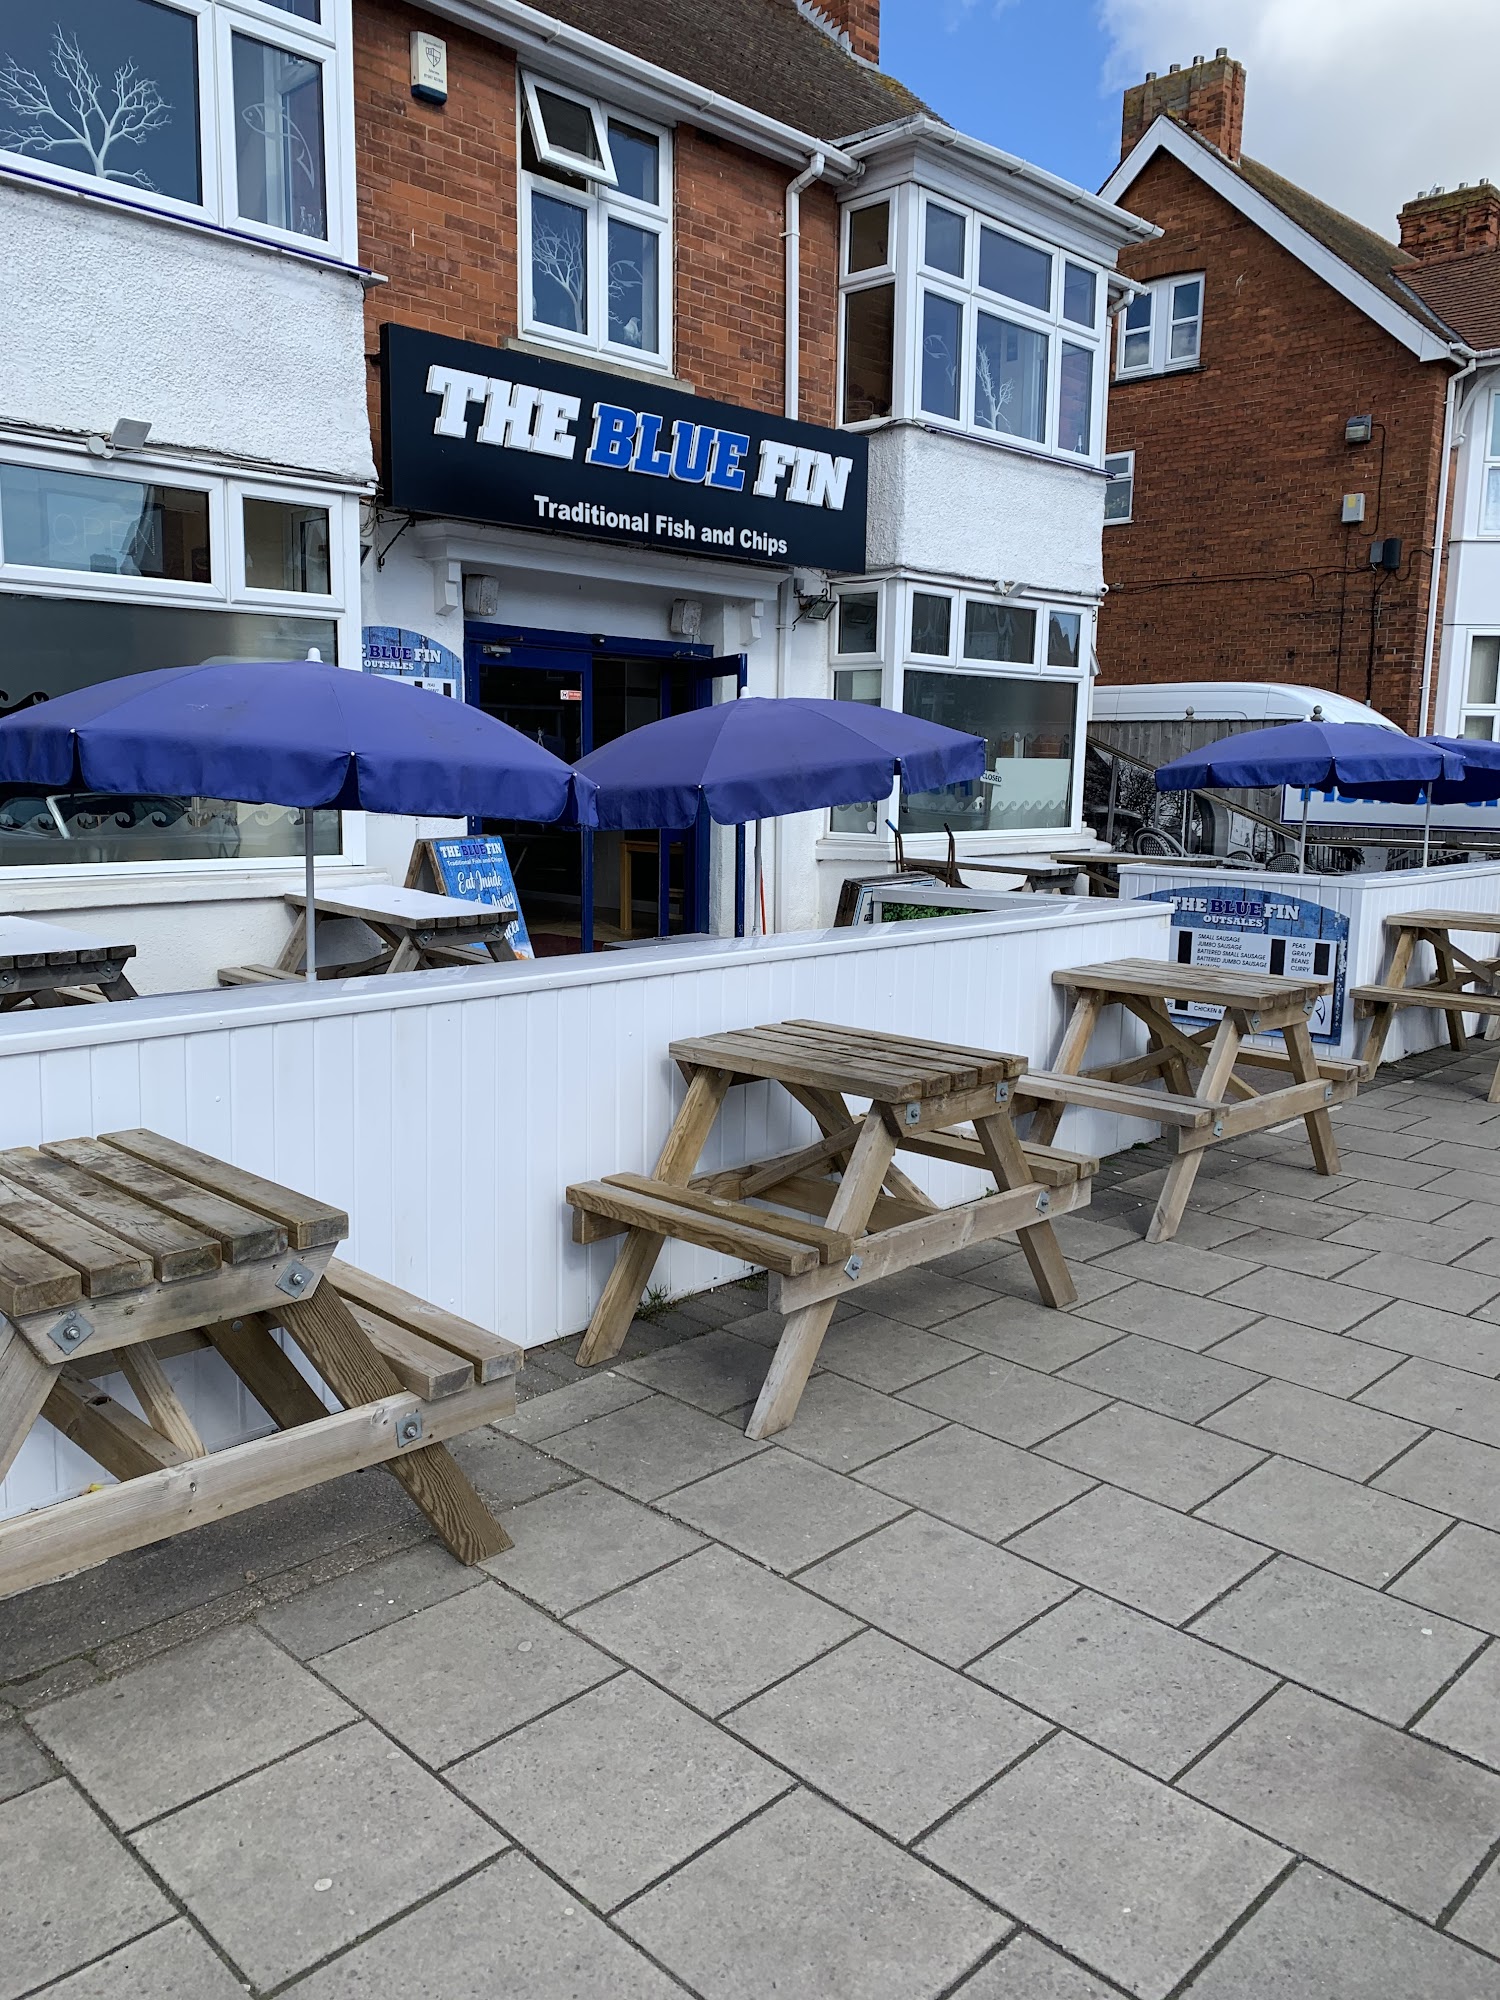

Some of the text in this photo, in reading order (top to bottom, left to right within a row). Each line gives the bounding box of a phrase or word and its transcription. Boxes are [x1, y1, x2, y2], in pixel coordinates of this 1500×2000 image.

[426, 364, 853, 511] THE BLUE FIN
[534, 494, 788, 556] Traditional Fish and Chips
[52, 513, 157, 556] OPEN
[369, 644, 412, 660] BLUE
[414, 648, 441, 664] FIN
[364, 660, 414, 670] OUTSALES
[982, 773, 1002, 783] CLOSED
[440, 842, 502, 858] THE BLUE FIN
[458, 870, 502, 894] Eat Inside
[1170, 896, 1300, 920] THE BLUE FIN
[1203, 915, 1263, 927] OUTSALES
[1240, 952, 1266, 960] SAUSAGE
[1241, 960, 1268, 968] SAUSAGE
[1193, 1005, 1217, 1014] CHICKEN
